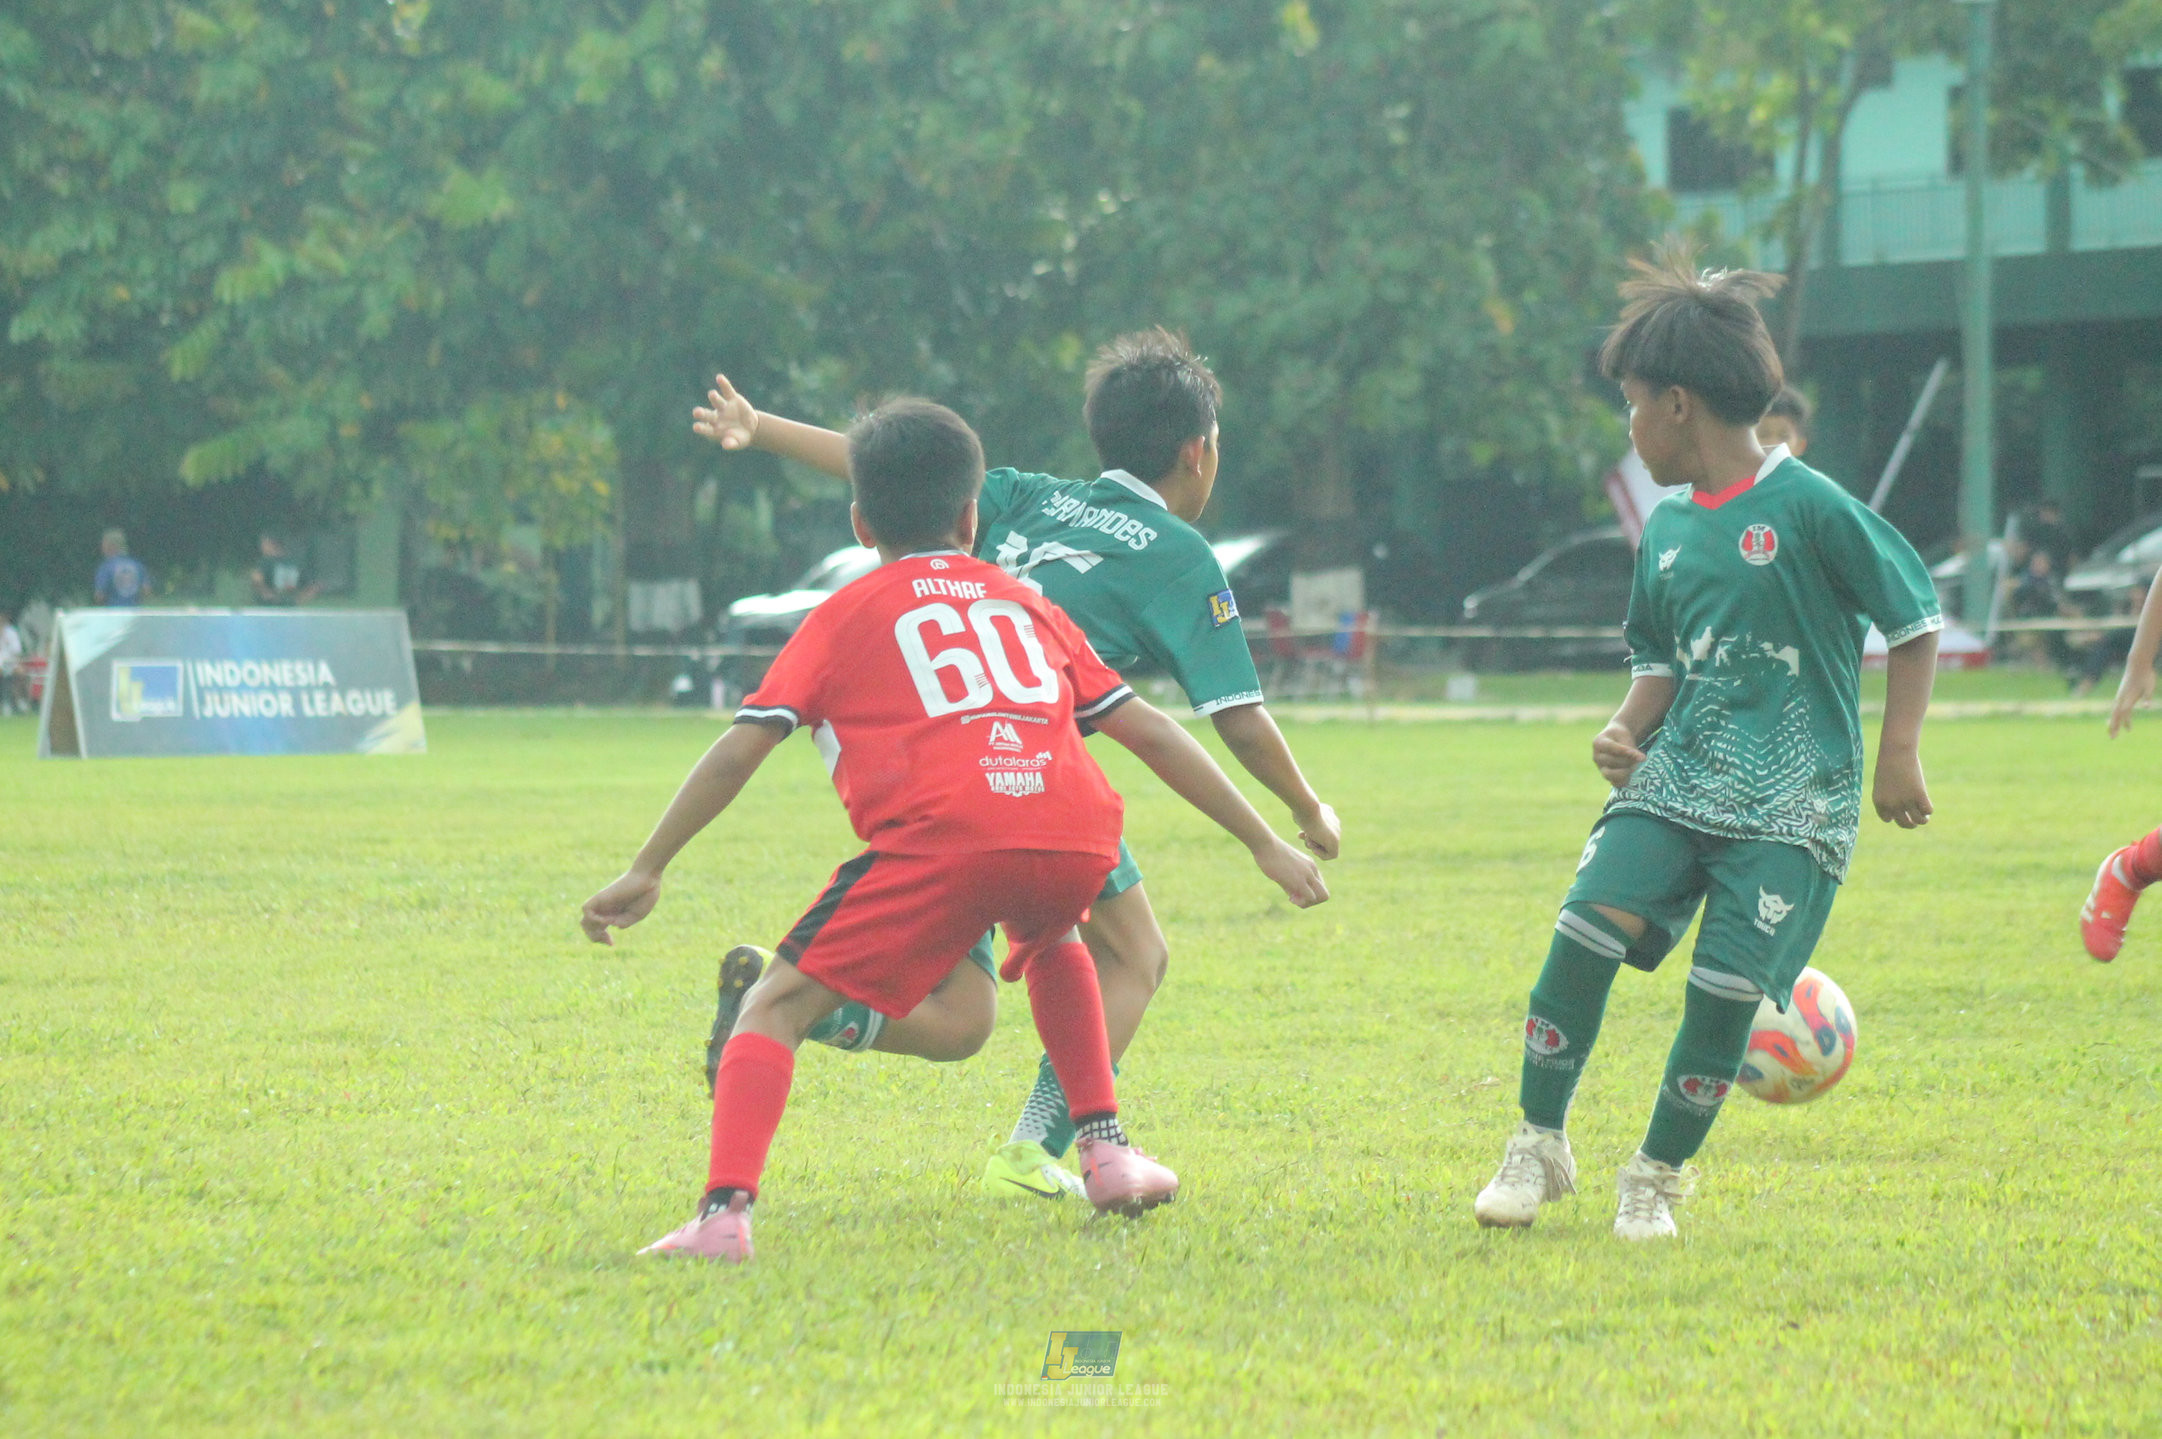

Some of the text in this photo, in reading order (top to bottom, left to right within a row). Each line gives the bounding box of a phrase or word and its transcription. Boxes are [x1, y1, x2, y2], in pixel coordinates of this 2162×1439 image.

[912, 577, 987, 600] ALTHAF
[894, 598, 1060, 719] 60
[196, 659, 337, 688] INDONESIA
[202, 689, 296, 718] JUNIOR
[301, 687, 398, 717] LEAGUE
[979, 756, 1047, 767] dutalaras
[985, 772, 1045, 792] YAMAHA
